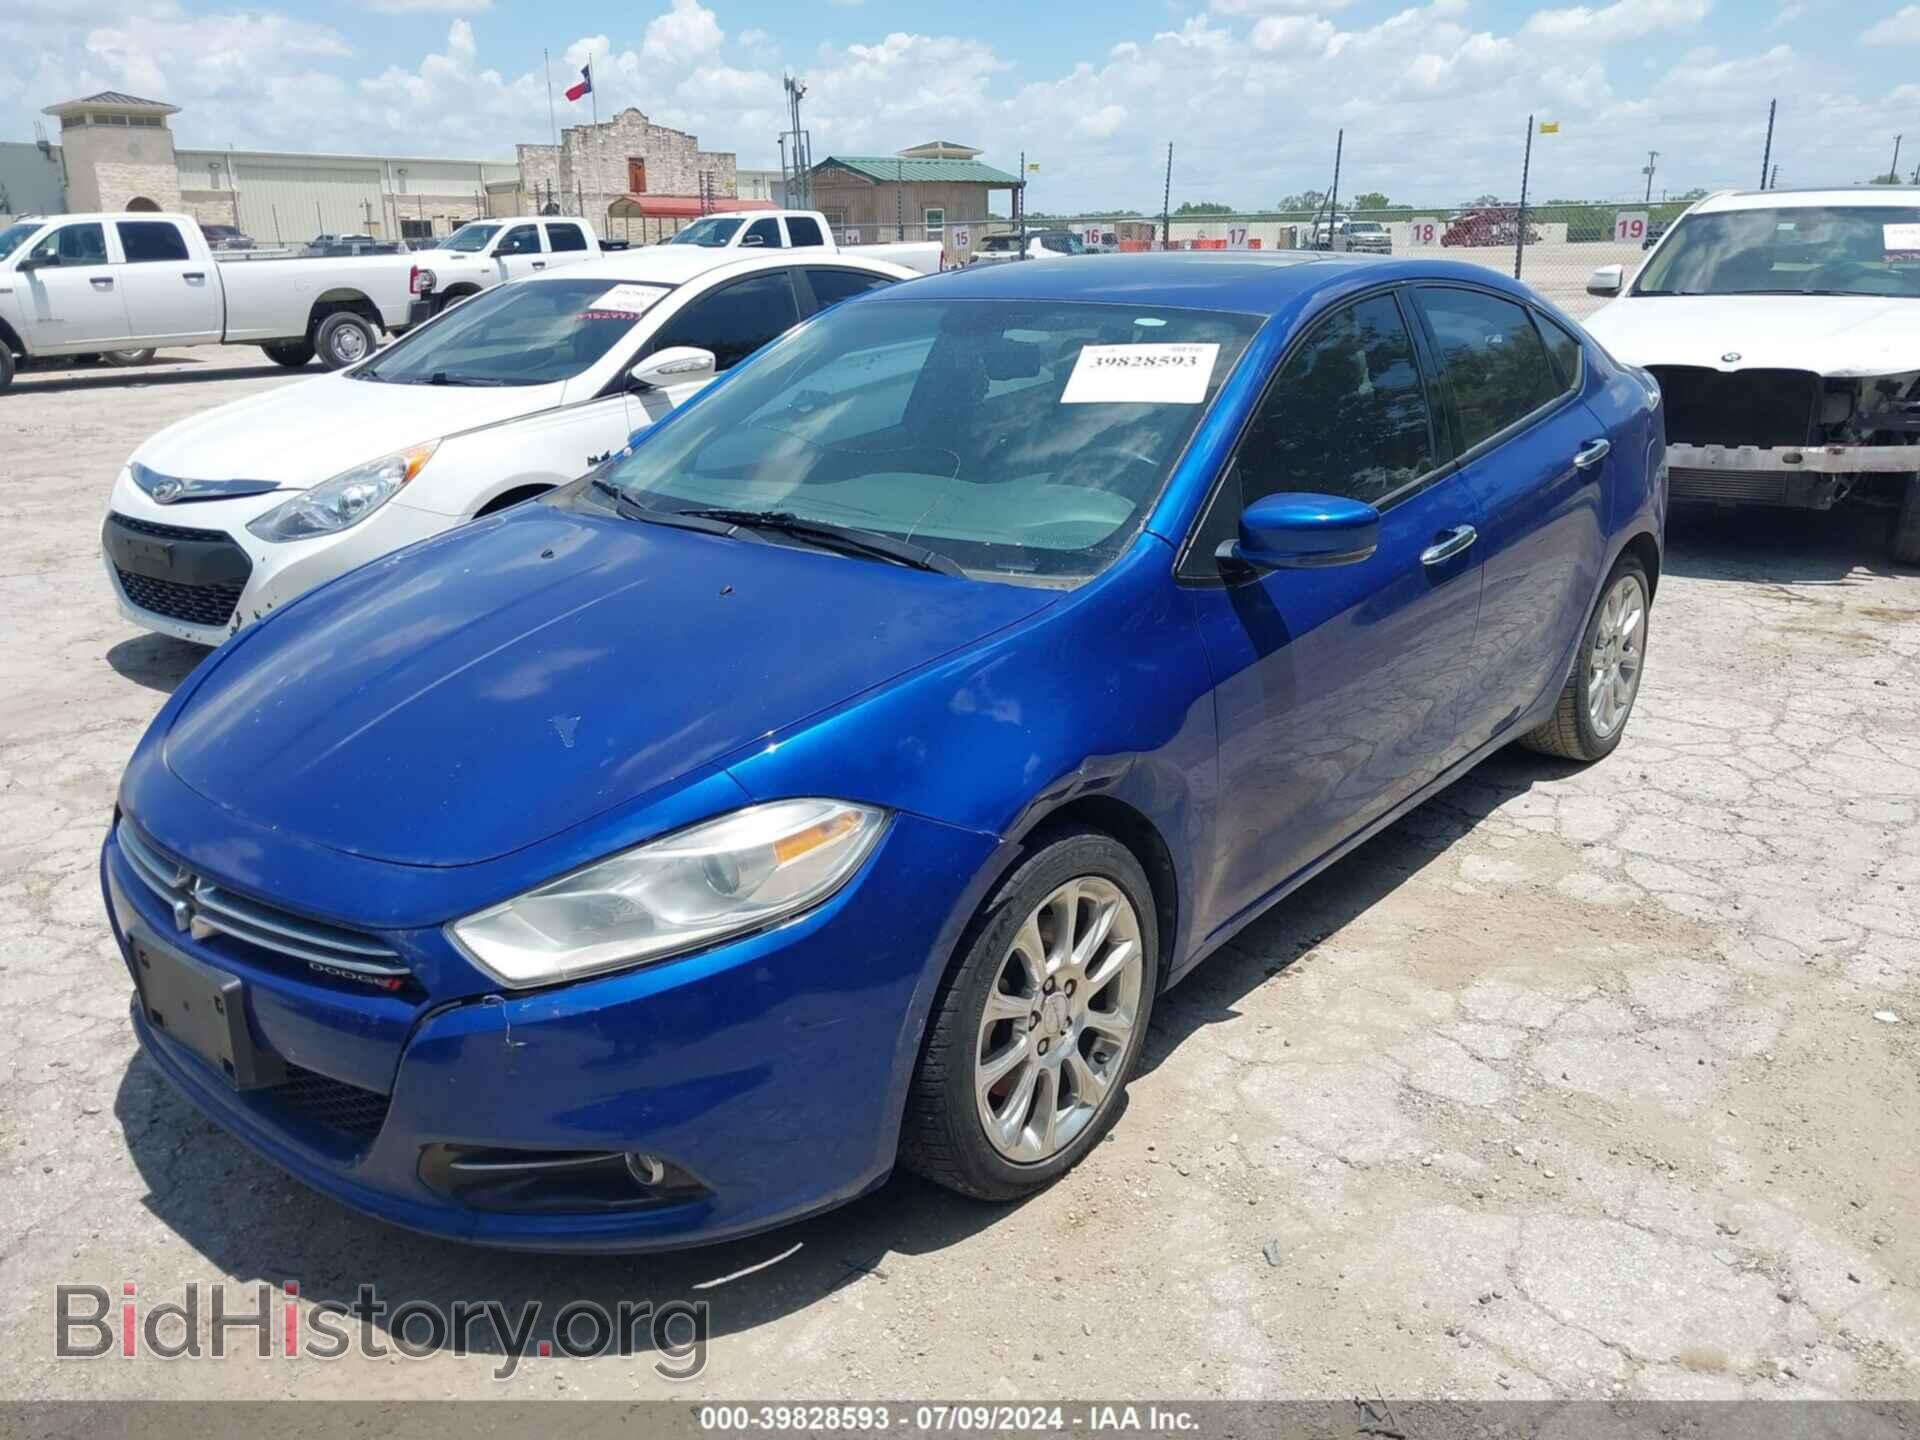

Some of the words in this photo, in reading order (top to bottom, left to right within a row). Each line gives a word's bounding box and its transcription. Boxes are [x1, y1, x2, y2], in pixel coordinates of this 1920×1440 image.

[1084, 229, 1100, 245] 16
[1229, 228, 1247, 245] 17
[1412, 224, 1435, 241] 18
[1618, 219, 1644, 238] 19
[954, 231, 969, 246] 15
[1089, 356, 1198, 368] 39828593
[309, 962, 388, 988] DODGE
